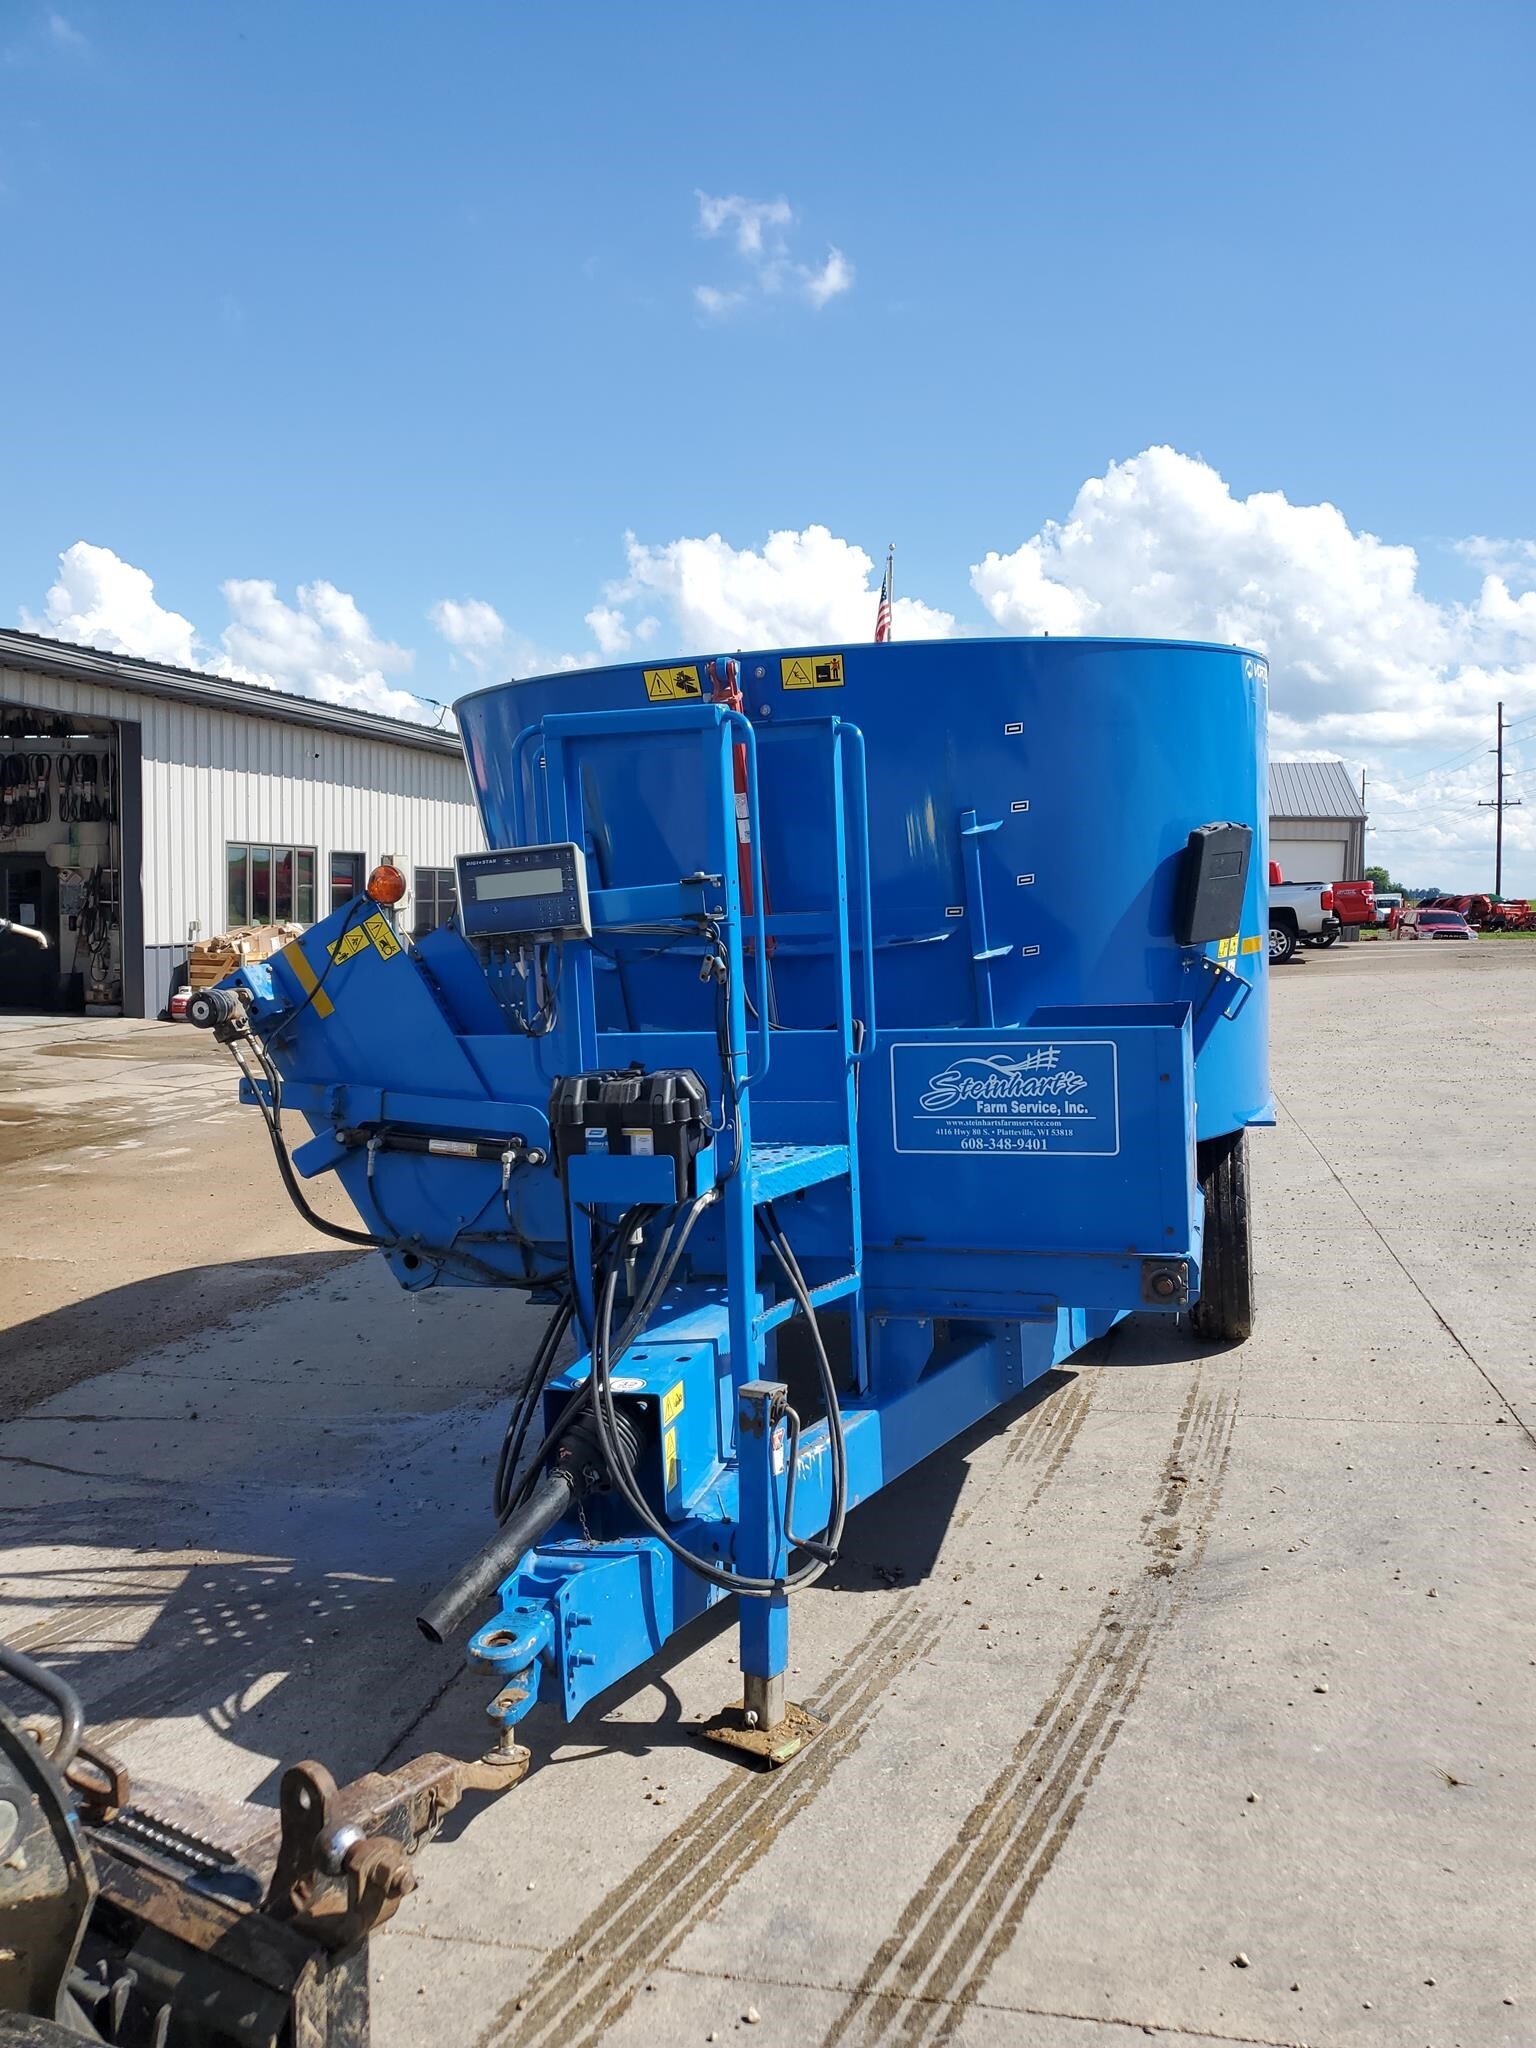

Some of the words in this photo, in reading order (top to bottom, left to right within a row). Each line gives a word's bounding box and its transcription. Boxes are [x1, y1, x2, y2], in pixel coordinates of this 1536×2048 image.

[919, 1070, 1088, 1112] Steinhart's
[976, 1100, 1008, 1114] Farm
[1011, 1100, 1061, 1116] Service,
[1064, 1100, 1089, 1114] Inc.
[945, 1119, 1062, 1127] www.steinhartsfarmservice.com
[935, 1128, 953, 1136] 4116
[954, 1128, 971, 1137] Hwy
[972, 1128, 981, 1136] 80
[982, 1128, 991, 1136] S.
[996, 1128, 1036, 1137] Platteville,
[1037, 1128, 1050, 1137] WI
[1050, 1128, 1074, 1137] 53818
[960, 1137, 1048, 1150] 608-348-9401
